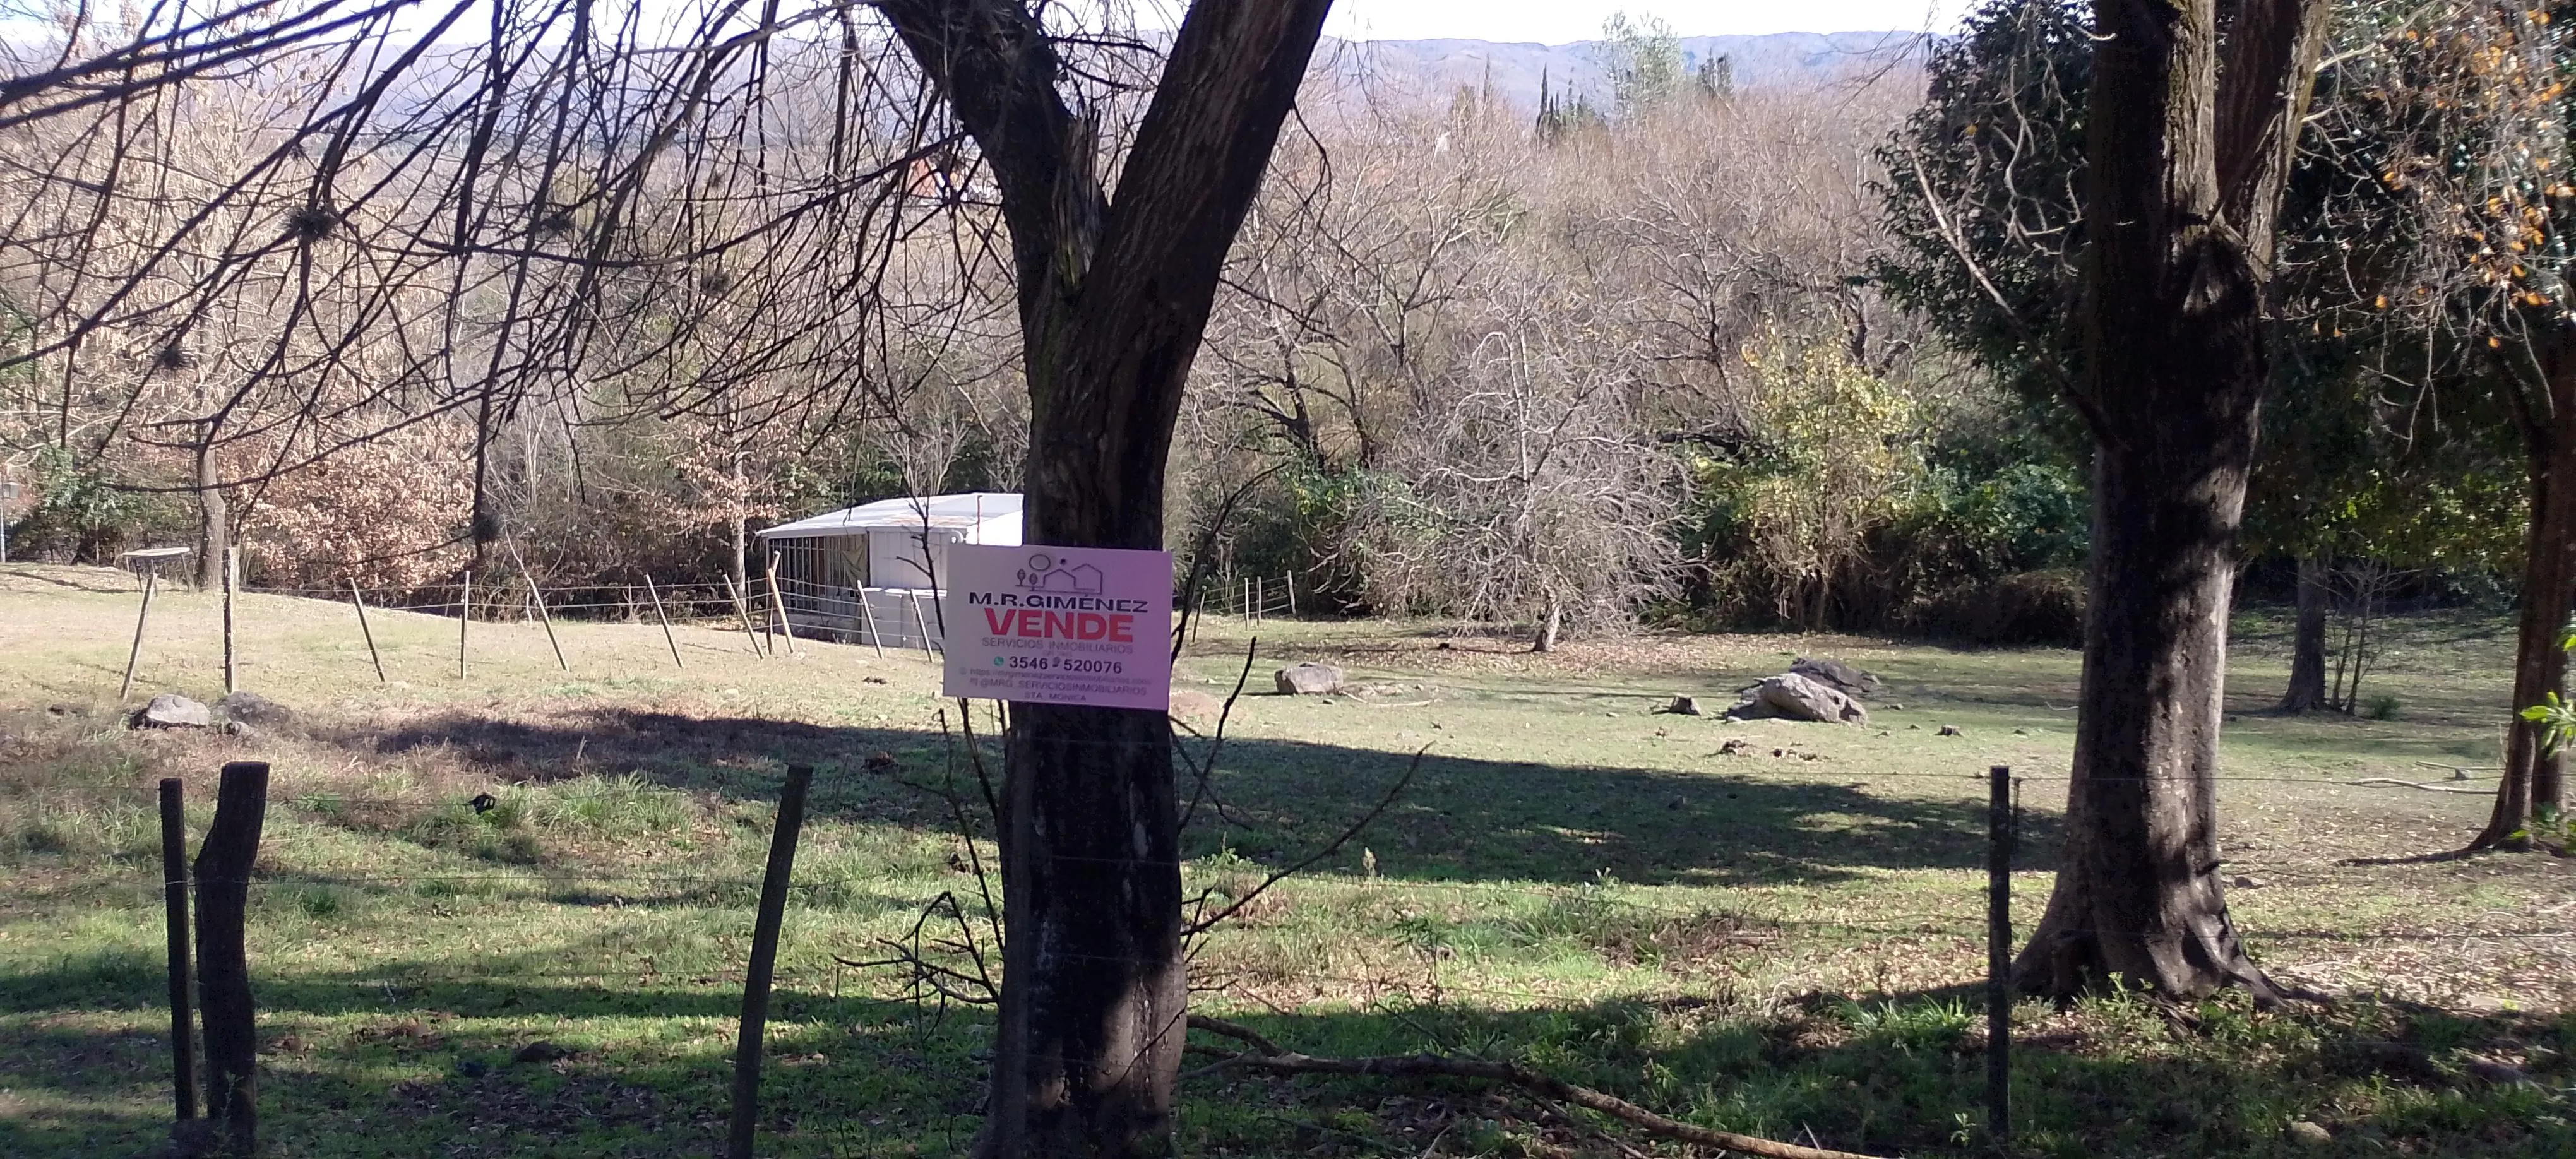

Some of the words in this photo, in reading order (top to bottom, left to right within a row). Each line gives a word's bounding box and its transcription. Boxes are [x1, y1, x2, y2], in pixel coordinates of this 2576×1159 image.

[984, 607, 1133, 643] VENDE
[982, 637, 1043, 650] SERVICIOS
[1049, 642, 1133, 655] INMOBILIARIOS
[1009, 656, 1048, 670] 3546
[1063, 658, 1122, 674] 520076
